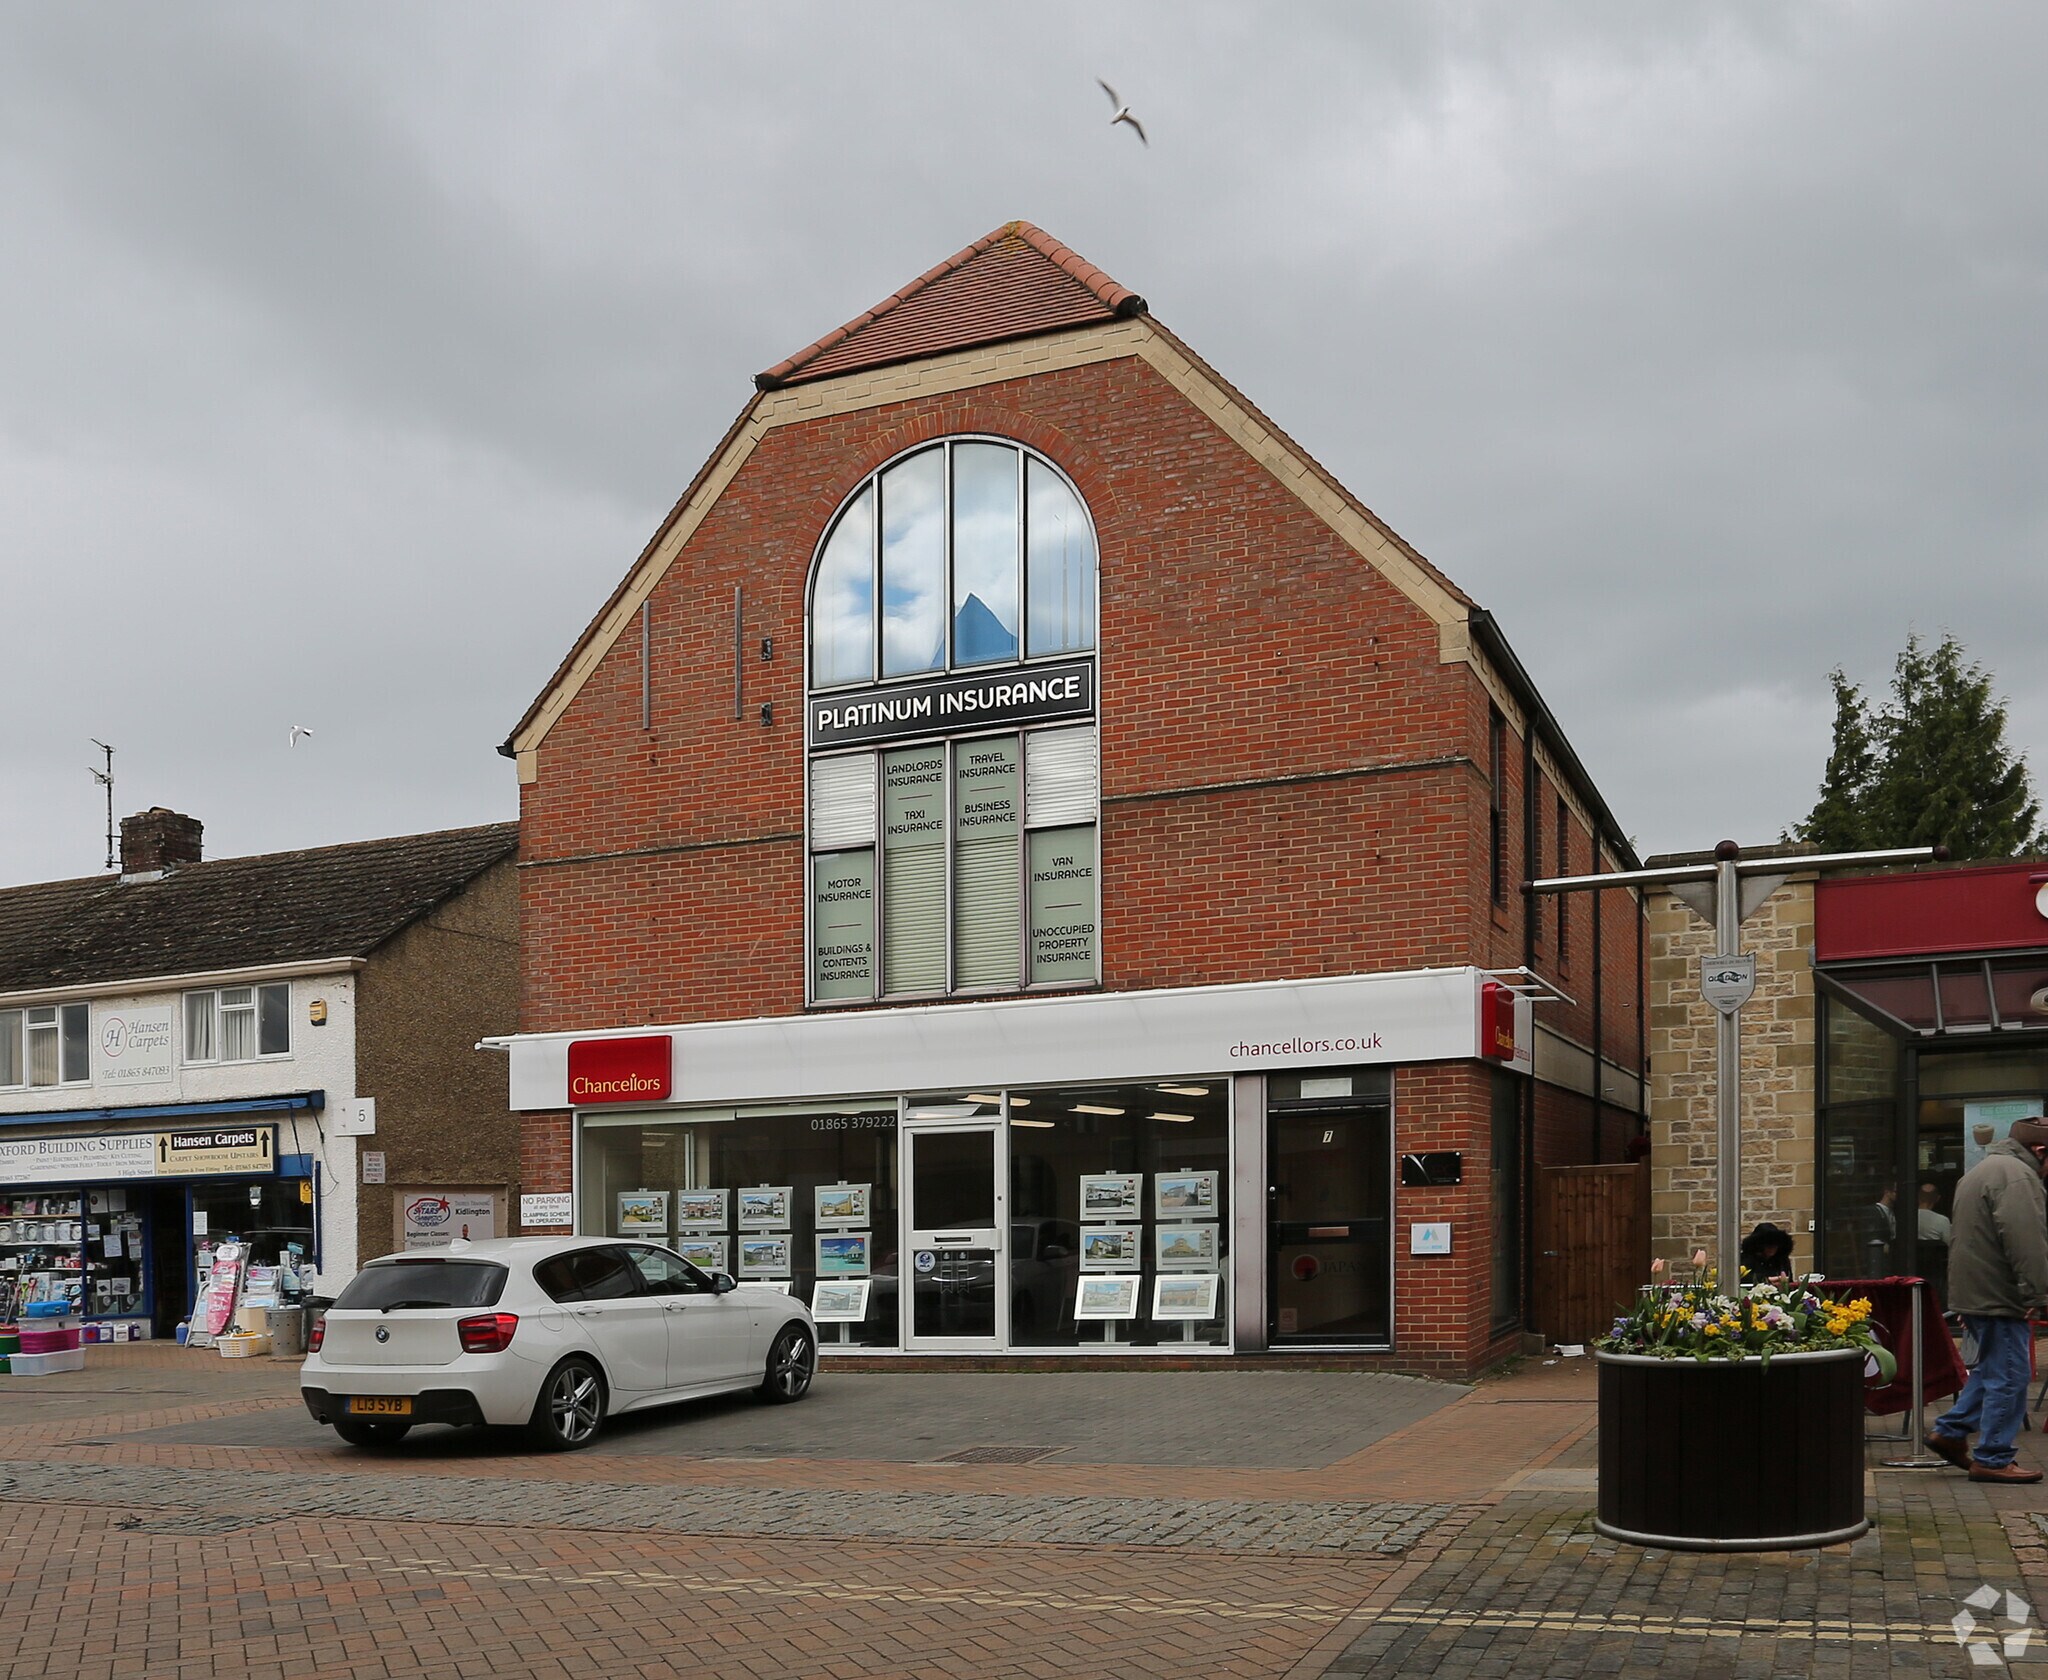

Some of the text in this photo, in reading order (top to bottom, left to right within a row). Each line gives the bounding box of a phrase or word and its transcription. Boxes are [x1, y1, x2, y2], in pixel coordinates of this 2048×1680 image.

[818, 676, 1081, 731] PLATINUM INSURANCE
[969, 752, 1006, 764] TRAVEL
[886, 760, 942, 774] LANDLORDS
[959, 764, 1016, 778] INSURANCE
[888, 772, 942, 788] INSURANCE
[964, 800, 1010, 814] BUSINESS
[904, 810, 926, 820] TAXI
[960, 812, 1016, 827] INSURANCE
[888, 820, 942, 835] INSURANCE
[1052, 856, 1074, 866] VAN
[1034, 868, 1092, 882] INSURANCE
[828, 878, 862, 890] MOTOR
[818, 890, 872, 903] INSURANCE
[1032, 924, 1095, 938] UNOCCUPIED
[818, 943, 872, 956] BUILDINGS &
[1038, 937, 1088, 950] PROPERTY
[822, 956, 868, 968] CONTENTS
[1036, 950, 1090, 964] INSURANCE
[820, 969, 870, 981] INSURANCE
[128, 1020, 169, 1034] Hansen
[128, 1036, 169, 1052] Carpets
[1230, 1032, 1382, 1057] chancellors.co.uk
[118, 1068, 140, 1078] 01865
[142, 1066, 170, 1076] 847093
[572, 1072, 660, 1094] Chancellors
[358, 1110, 366, 1122] 5
[810, 1116, 896, 1130] 01865 379222
[39, 1140, 96, 1154] BUILDING
[100, 1138, 152, 1150] SUPPLIES
[173, 1133, 254, 1148] Hansen Carpets
[536, 1196, 570, 1204] PARKING
[357, 1398, 402, 1412] L13 SYB
